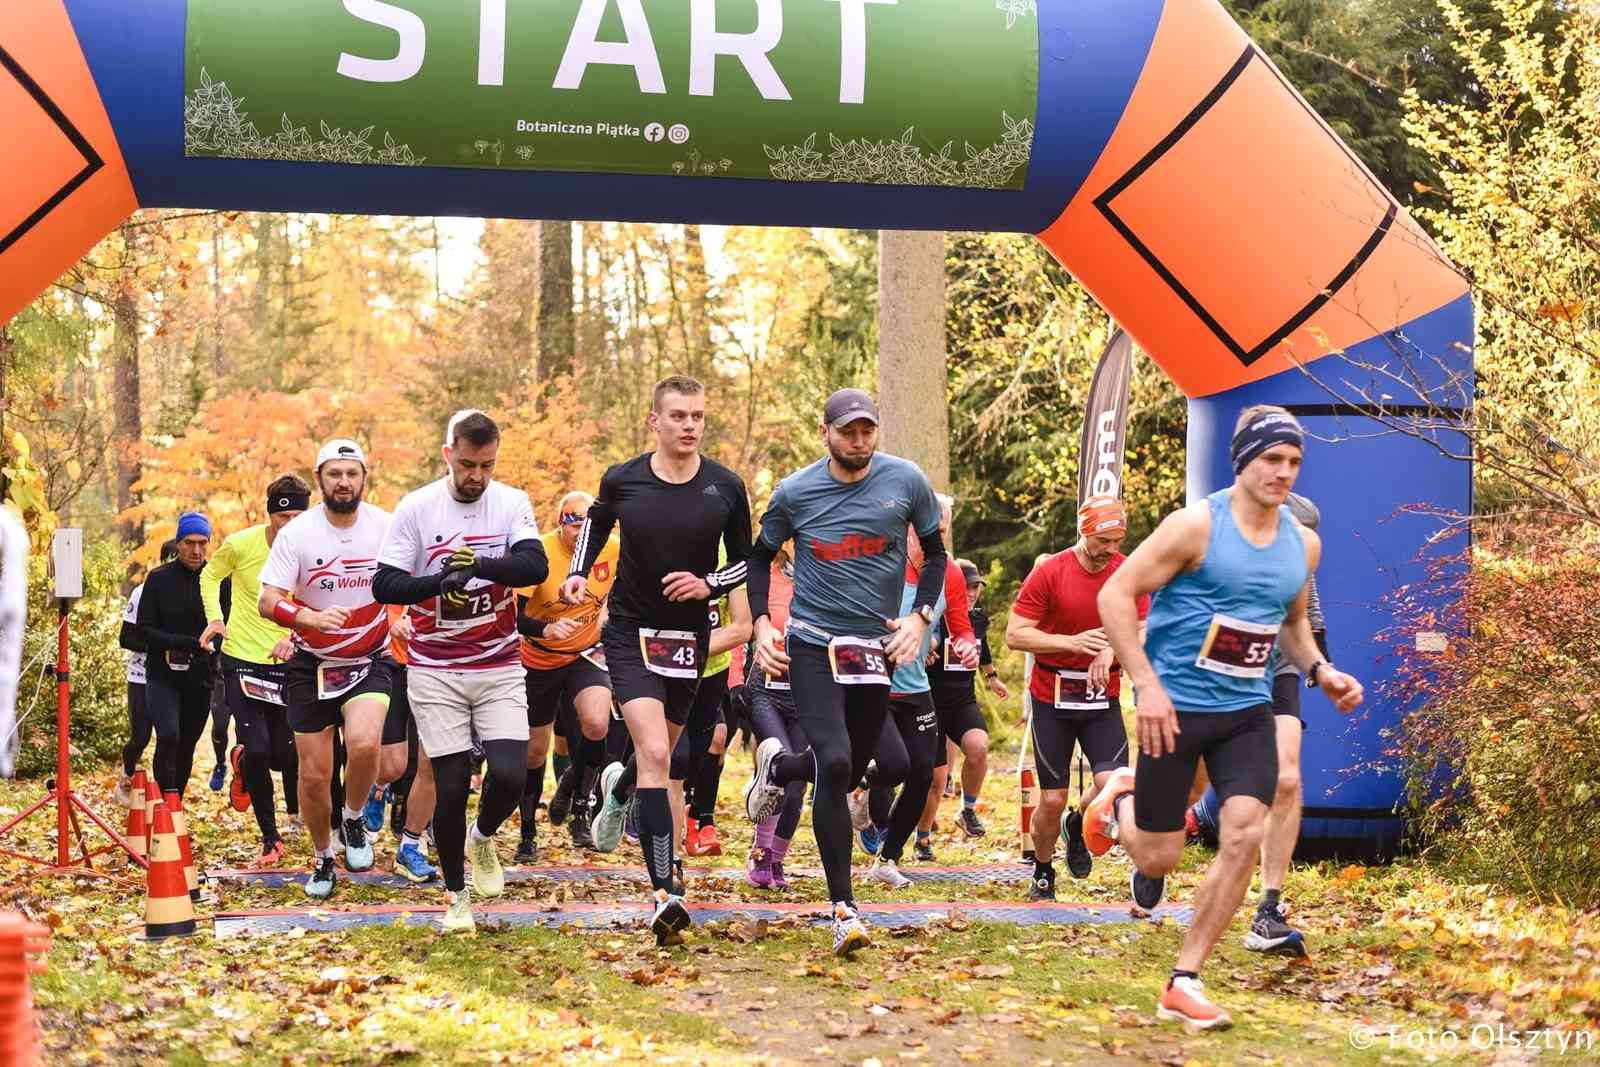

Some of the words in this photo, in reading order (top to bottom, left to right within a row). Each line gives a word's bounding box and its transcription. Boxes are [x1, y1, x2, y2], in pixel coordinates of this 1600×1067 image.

[516, 119, 593, 135] Botaniczna
[596, 123, 640, 139] Piątka
[319, 578, 335, 592] Są
[337, 575, 373, 589] Wolni
[468, 593, 493, 615] 73
[672, 646, 696, 666] 43
[1243, 642, 1273, 664] 53
[865, 654, 885, 674] 55
[1085, 683, 1106, 701] 52
